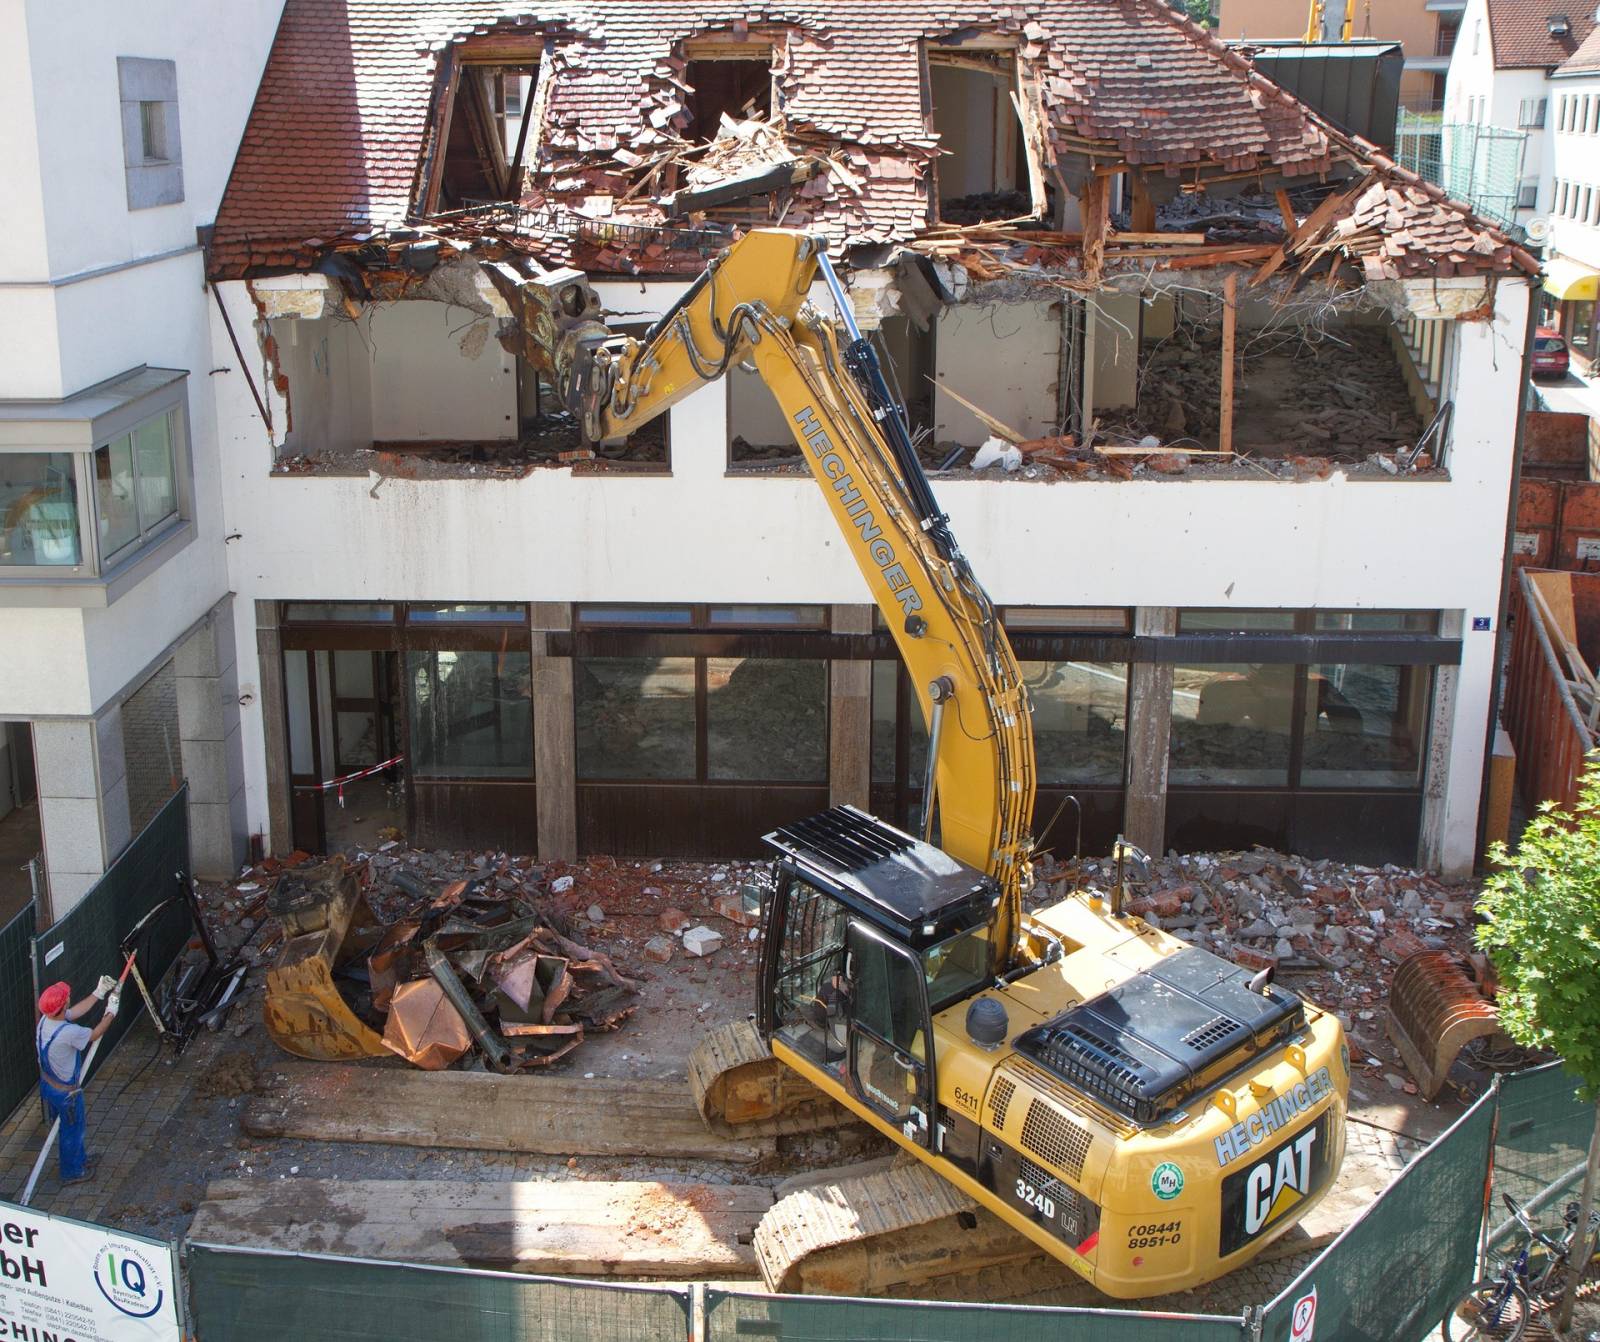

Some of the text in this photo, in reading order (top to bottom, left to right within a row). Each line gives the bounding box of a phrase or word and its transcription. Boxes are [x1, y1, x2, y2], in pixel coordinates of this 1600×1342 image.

[793, 406, 923, 616] HECHINGER
[954, 1086, 978, 1110] 6411
[1213, 1066, 1334, 1167] HECHINGER
[1016, 1178, 1077, 1235] 324D LN
[1245, 1127, 1316, 1234] CAT
[0, 1222, 39, 1248] er
[1128, 1233, 1181, 1249] 8951-0
